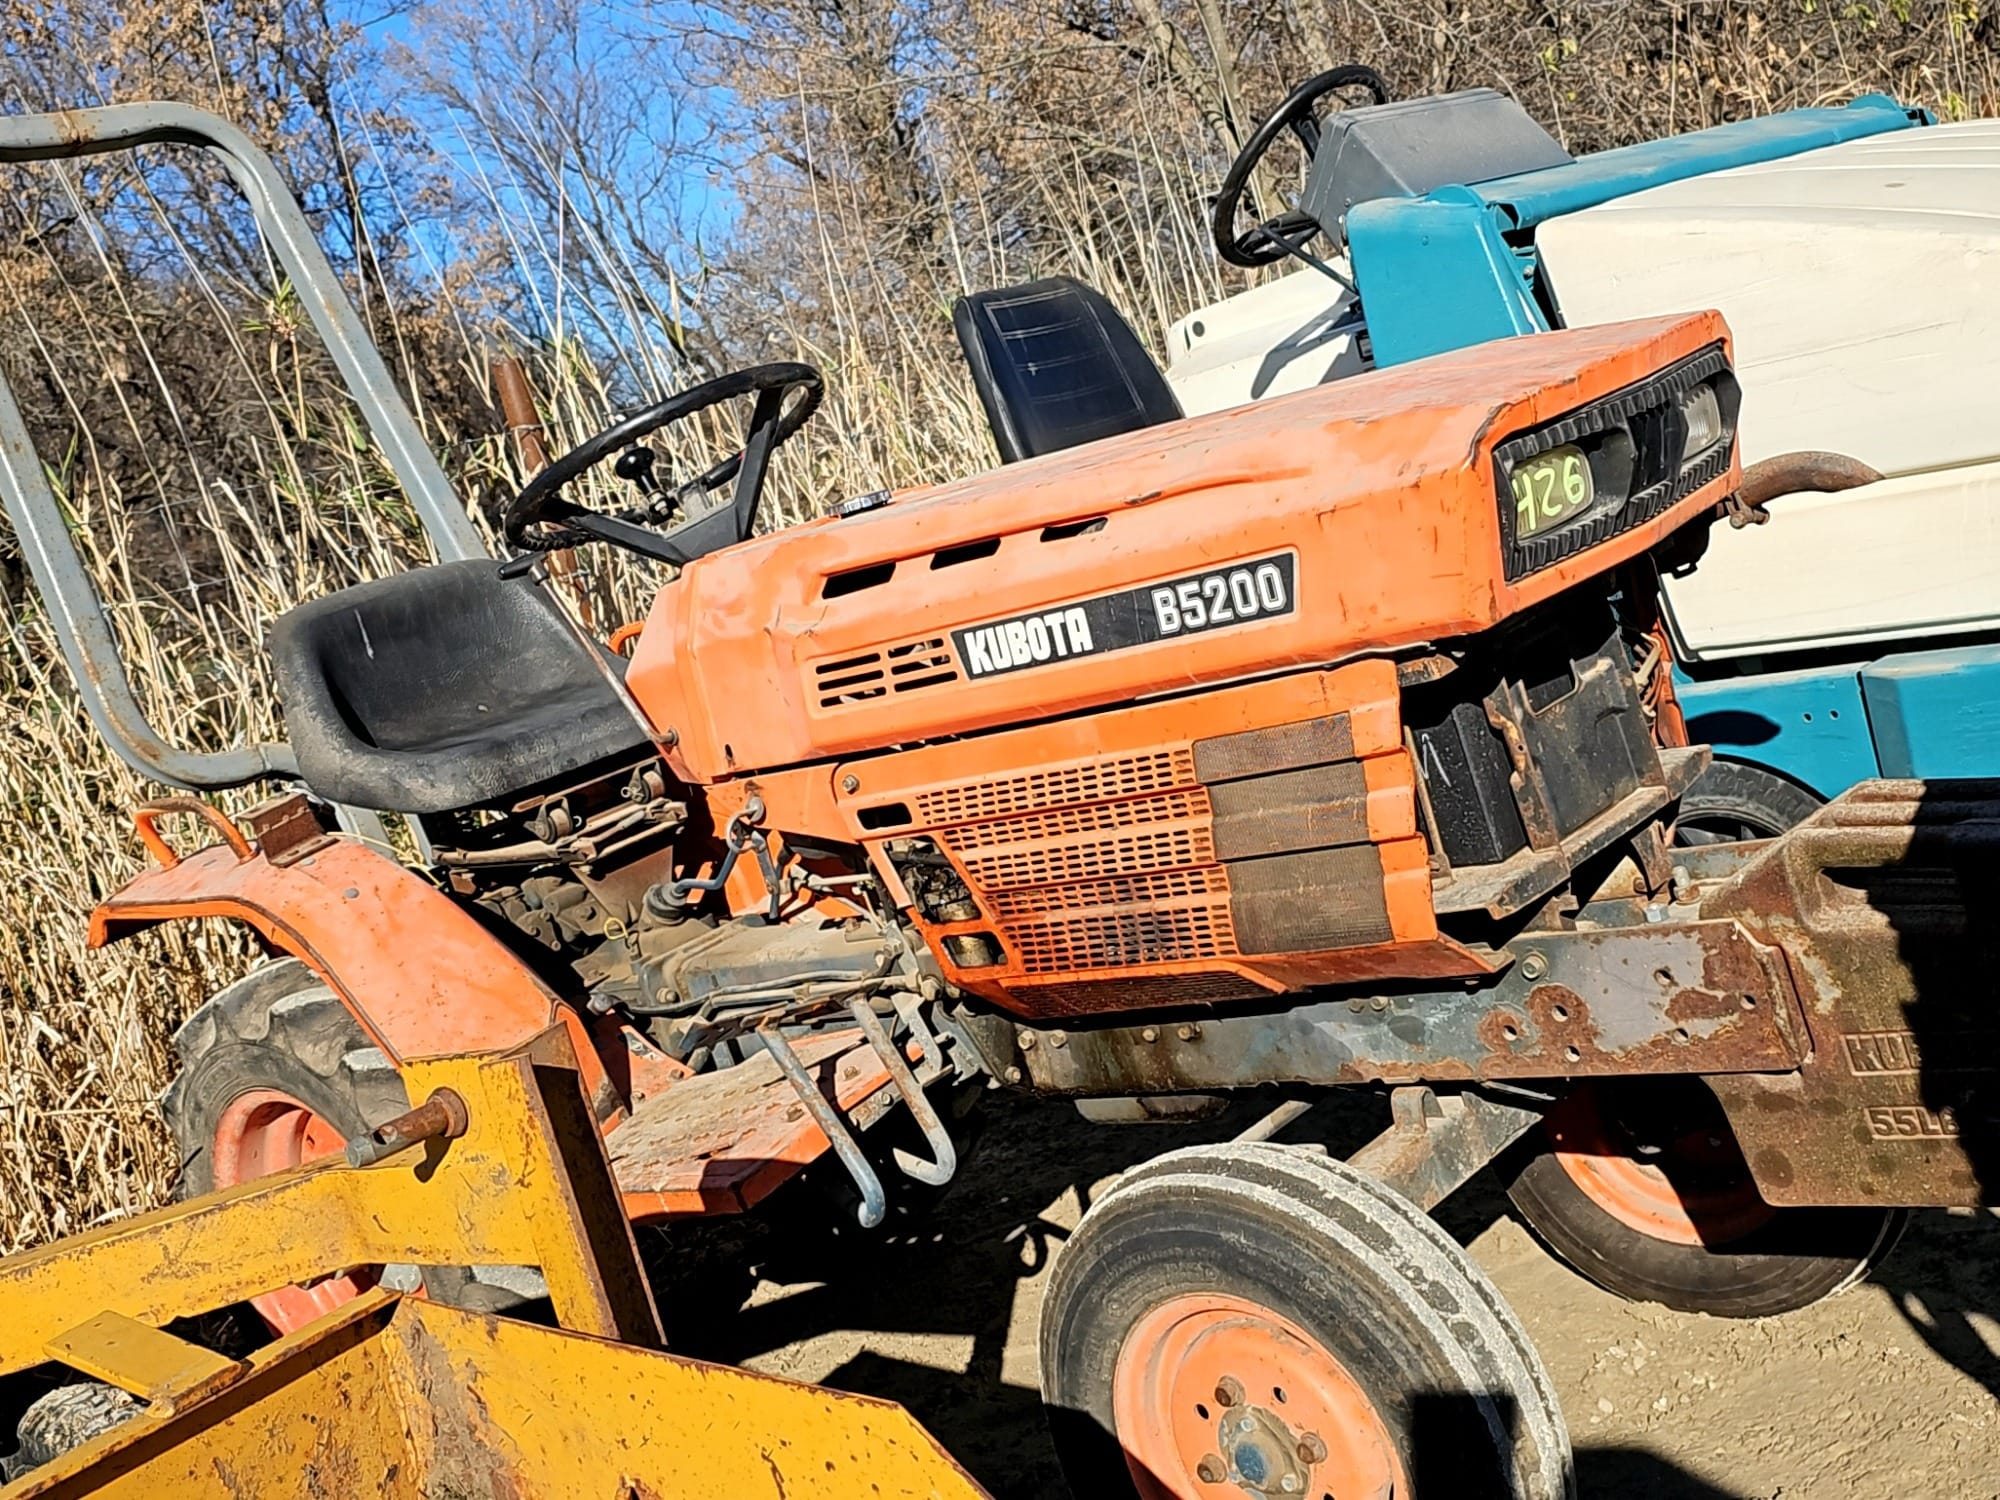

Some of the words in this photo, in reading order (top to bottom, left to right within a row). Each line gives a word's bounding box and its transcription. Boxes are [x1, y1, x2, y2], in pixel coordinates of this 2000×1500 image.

[1512, 455, 1585, 530] 426
[963, 607, 1093, 675] KUBOTA
[1152, 563, 1286, 635] B5200
